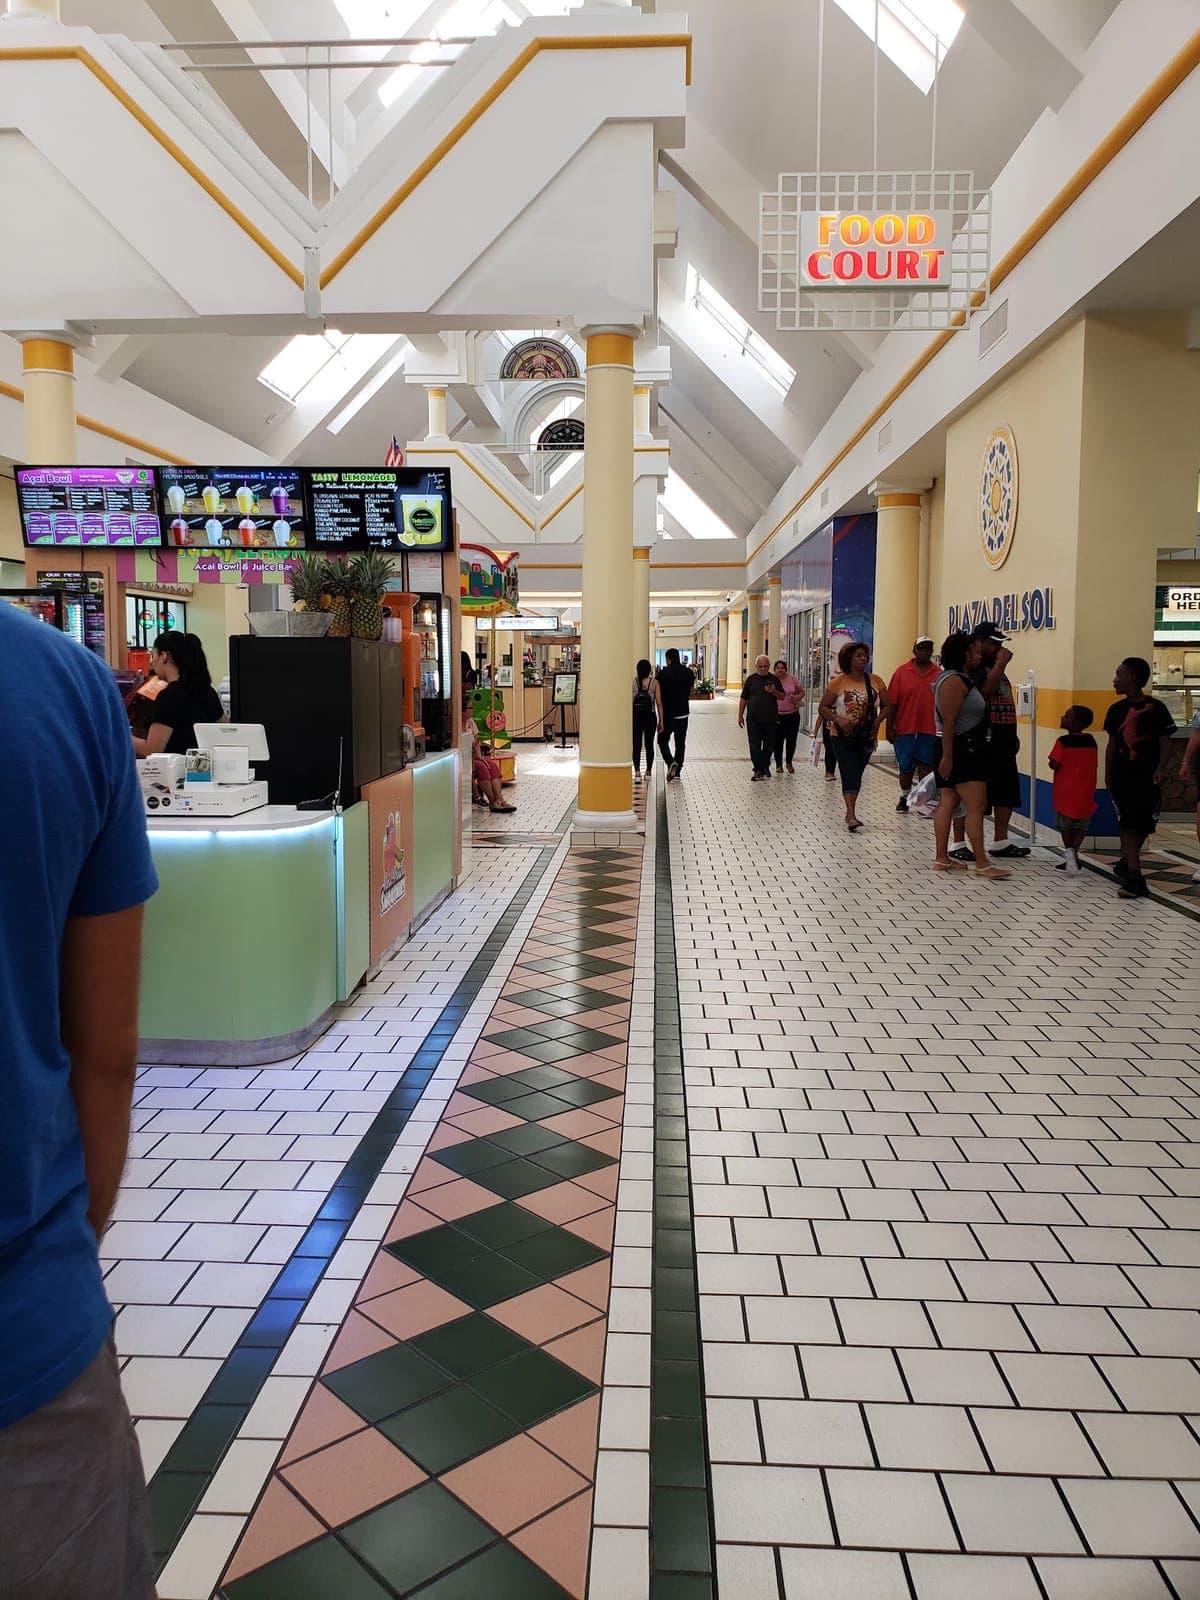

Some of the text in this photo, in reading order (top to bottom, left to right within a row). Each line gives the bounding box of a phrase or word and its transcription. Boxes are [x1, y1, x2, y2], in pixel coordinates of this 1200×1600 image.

[818, 214, 936, 247] FOOD
[807, 249, 945, 281] COURT
[46, 474, 72, 484] Bowl
[311, 472, 396, 482] TASTY LEMONADES
[949, 588, 1055, 636] PLAZA DEL SOL
[1177, 602, 1200, 610] HE
